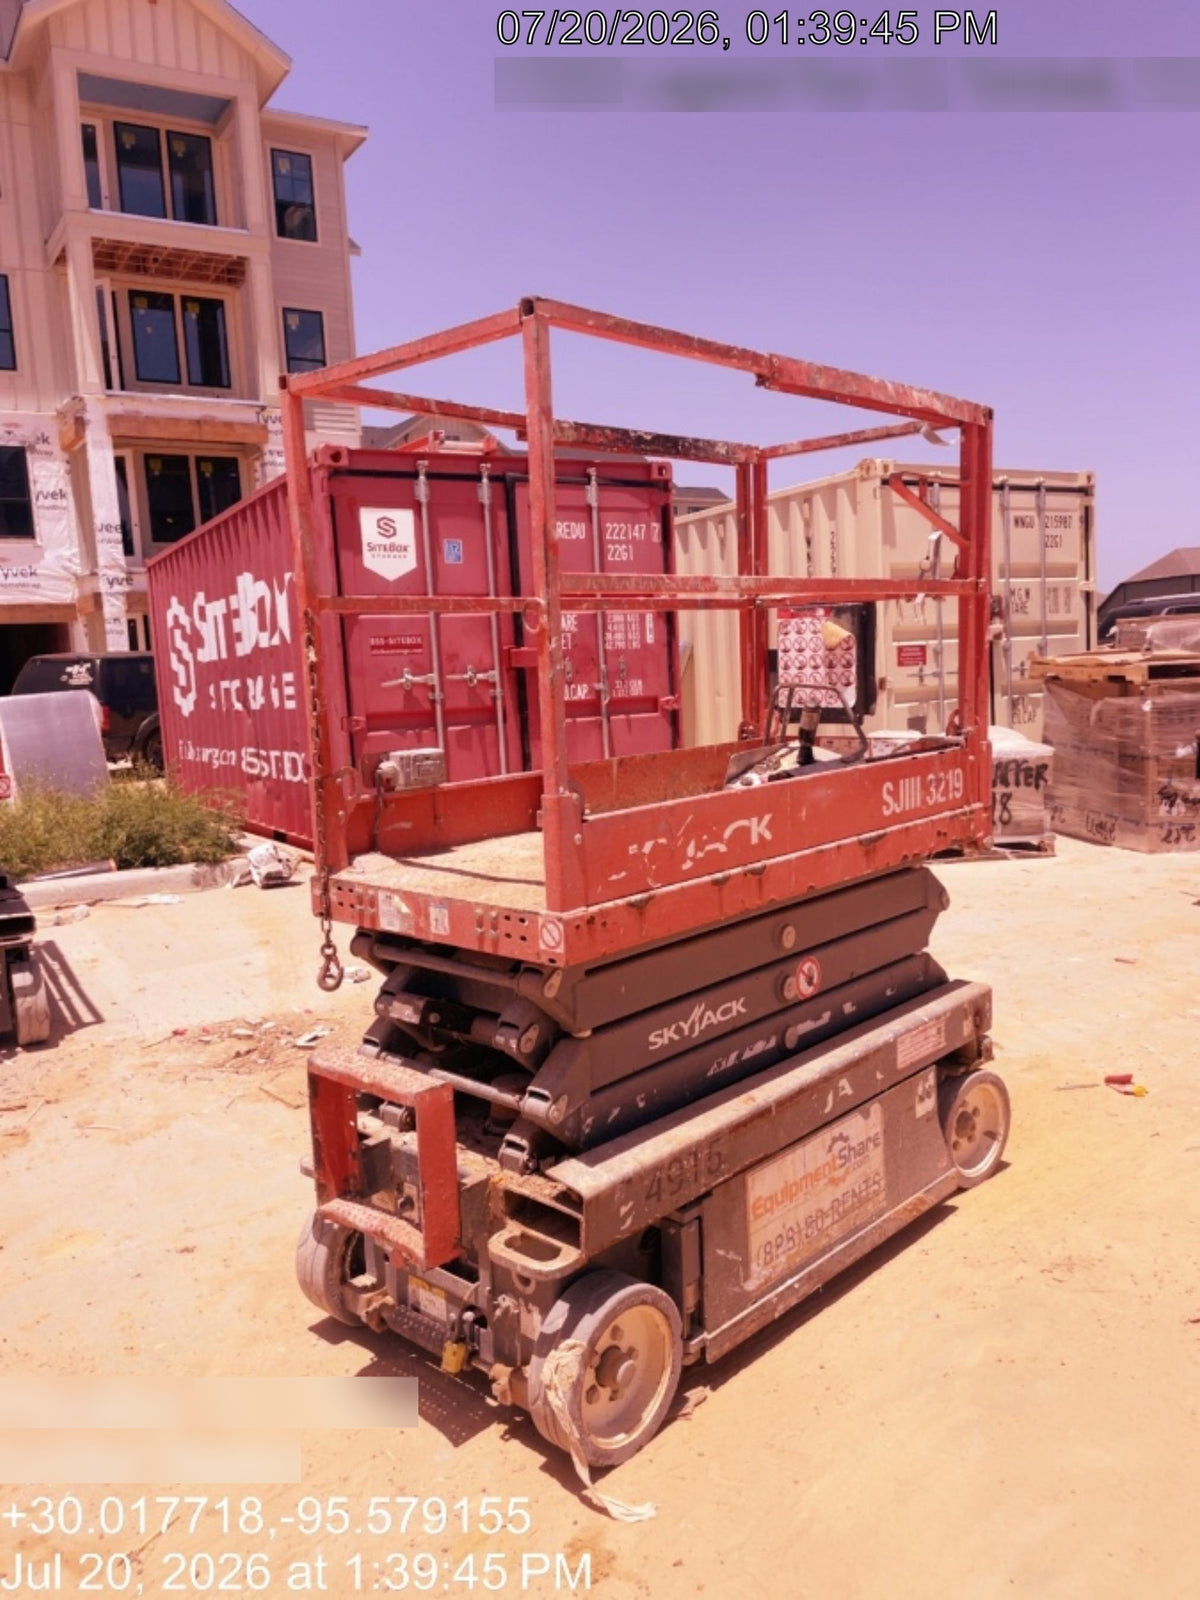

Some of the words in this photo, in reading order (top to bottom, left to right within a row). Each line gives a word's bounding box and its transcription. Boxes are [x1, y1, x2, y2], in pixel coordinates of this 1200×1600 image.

[556, 521, 586, 540] REDU
[605, 522, 647, 541] 222147
[0, 565, 38, 580] yvek
[561, 614, 578, 632] ARE
[561, 632, 572, 650] ET
[926, 767, 963, 806] 3219
[648, 997, 747, 1050] SKYJACK
[645, 1137, 723, 1203] 4915
